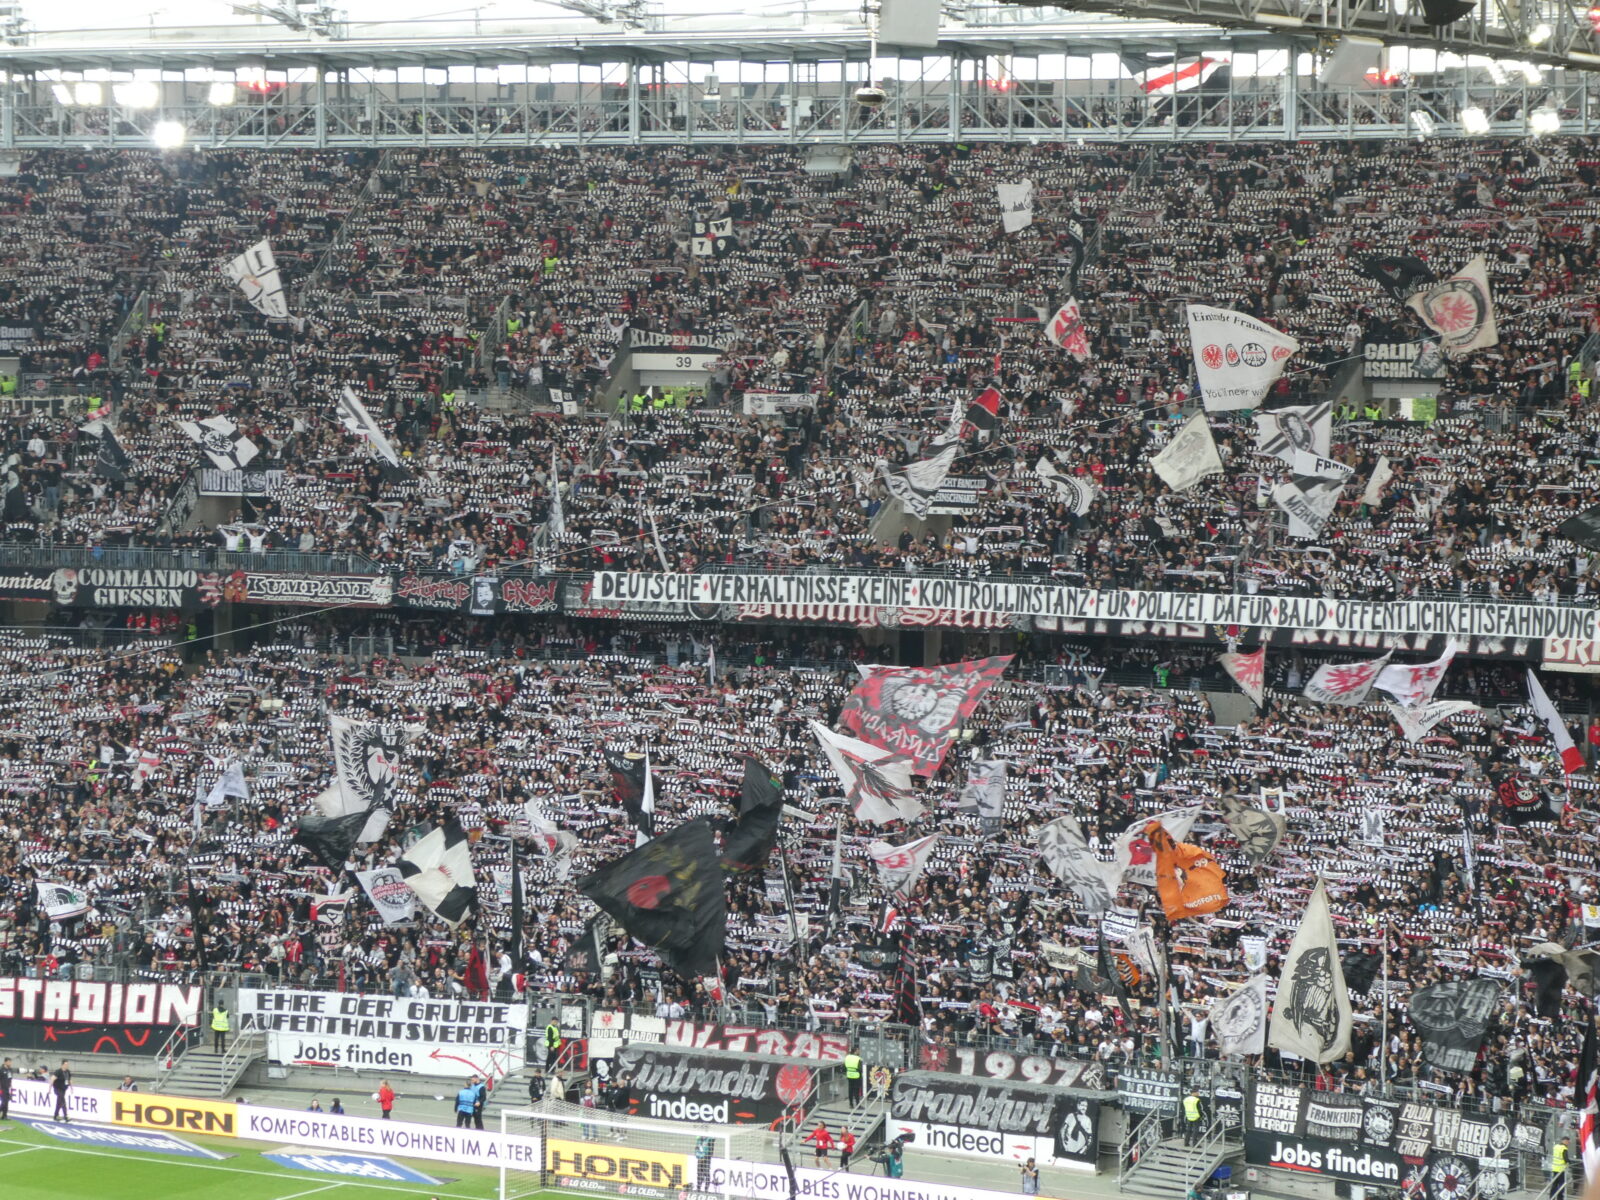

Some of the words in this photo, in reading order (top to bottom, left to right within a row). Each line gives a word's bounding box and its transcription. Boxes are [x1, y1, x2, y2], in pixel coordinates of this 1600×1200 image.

[676, 356, 692, 368] 39
[0, 572, 55, 591] united
[77, 568, 198, 588] COMMANDO
[247, 575, 371, 597] KUMPANE
[94, 588, 182, 607] GIESSEN
[502, 578, 558, 607] CREW
[602, 573, 701, 601] DEUTSCHE
[857, 576, 911, 606] KEINE
[919, 581, 1089, 616] KONTROLLINSTANZ
[1096, 589, 1130, 617] FÜR
[1214, 594, 1272, 625] DAFÜR
[1278, 597, 1327, 627] BALD
[1334, 598, 1595, 640] ÖFFENTLICHKEITSFAHNDUNG
[0, 977, 204, 1027] STADION
[256, 992, 326, 1013] EHRE
[340, 997, 393, 1018] DER
[407, 1001, 510, 1024] GRUPPE
[240, 1012, 522, 1045] AUFENTHALTSVERBOT
[591, 1028, 619, 1039] NUOVA
[622, 1029, 660, 1043] GUARDIA
[666, 1019, 850, 1060] ULTRAS
[294, 1040, 341, 1063] Jobs
[346, 1044, 413, 1067] finden
[614, 1047, 770, 1100] Eintracht
[956, 1048, 1086, 1089] 1997
[1123, 1067, 1176, 1083] ULTRAS
[1126, 1081, 1171, 1097] NEVER
[34, 1091, 51, 1108] IM
[68, 1096, 98, 1114] LTER
[650, 1094, 729, 1123] indeed
[891, 1075, 1056, 1134] Frankfurt
[1254, 1105, 1298, 1121] STADION
[1256, 1094, 1300, 1110] GRUPPE
[1402, 1103, 1434, 1121] FULDA
[115, 1101, 233, 1133] HORN
[1254, 1117, 1296, 1134] VERBOT
[1310, 1107, 1362, 1124] FRANKFURT
[250, 1114, 375, 1145] KOMFORTABLES
[381, 1131, 455, 1151] WOHNEN
[461, 1139, 482, 1157] IM
[926, 1123, 1004, 1155] indeed
[1459, 1122, 1490, 1145] RIED
[1271, 1141, 1322, 1168] Jobs
[1325, 1149, 1399, 1180] finden
[1398, 1139, 1429, 1157] CREW
[1457, 1140, 1488, 1157] GEBIET
[552, 1150, 683, 1186] HORN
[713, 1169, 840, 1199] OMFORTBLES
